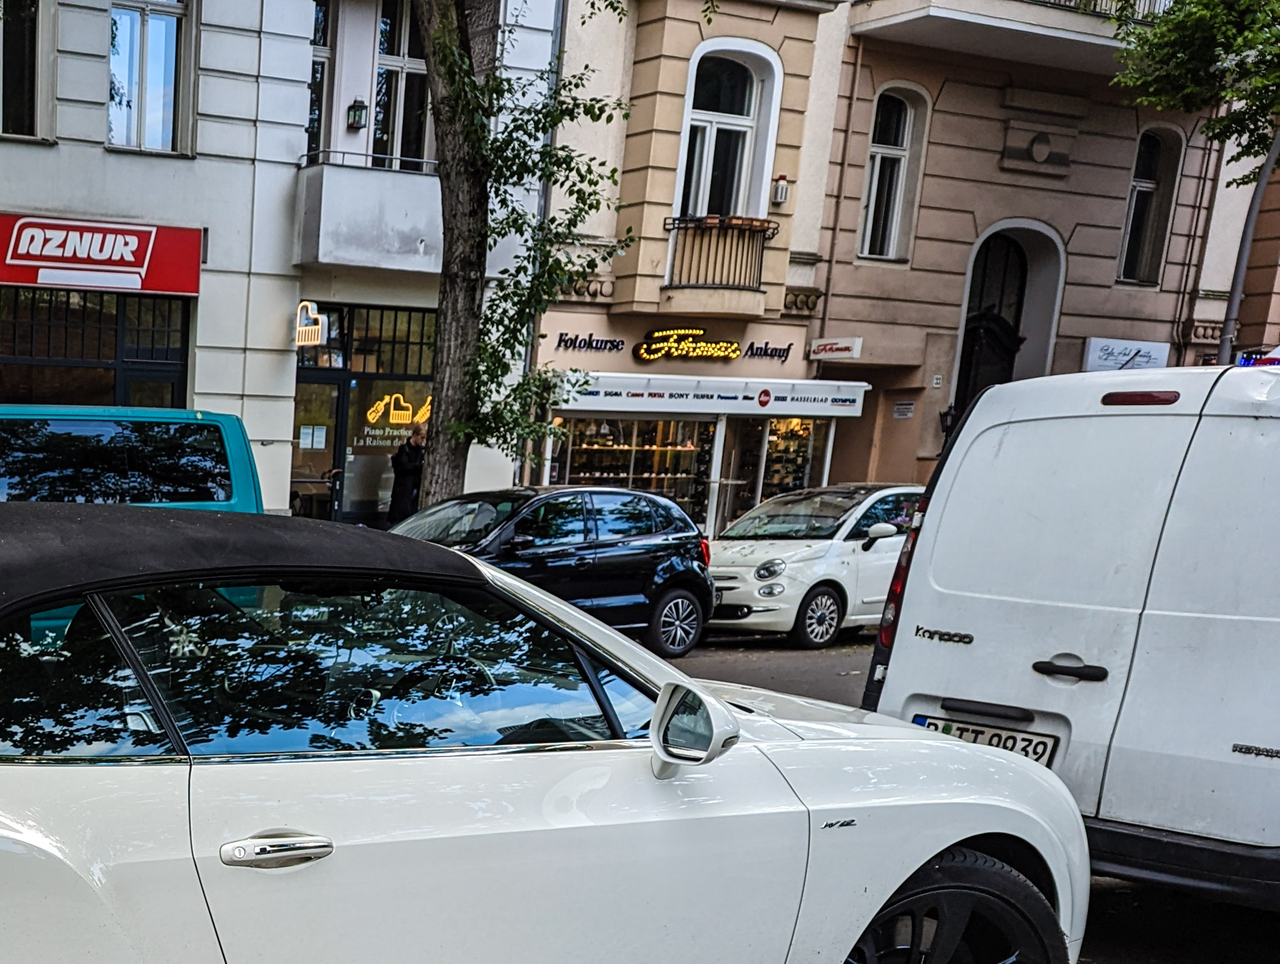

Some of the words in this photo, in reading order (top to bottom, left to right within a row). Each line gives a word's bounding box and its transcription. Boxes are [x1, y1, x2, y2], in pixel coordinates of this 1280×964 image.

[17, 227, 139, 262] AZNUR
[556, 332, 625, 350] Fotokurse
[743, 341, 794, 364] Ankauf
[790, 395, 828, 403] HASSELBLAD
[364, 426, 384, 436] Piano
[384, 426, 413, 436] Practice
[353, 436, 365, 446] La
[1231, 743, 1280, 759] RENAUL
